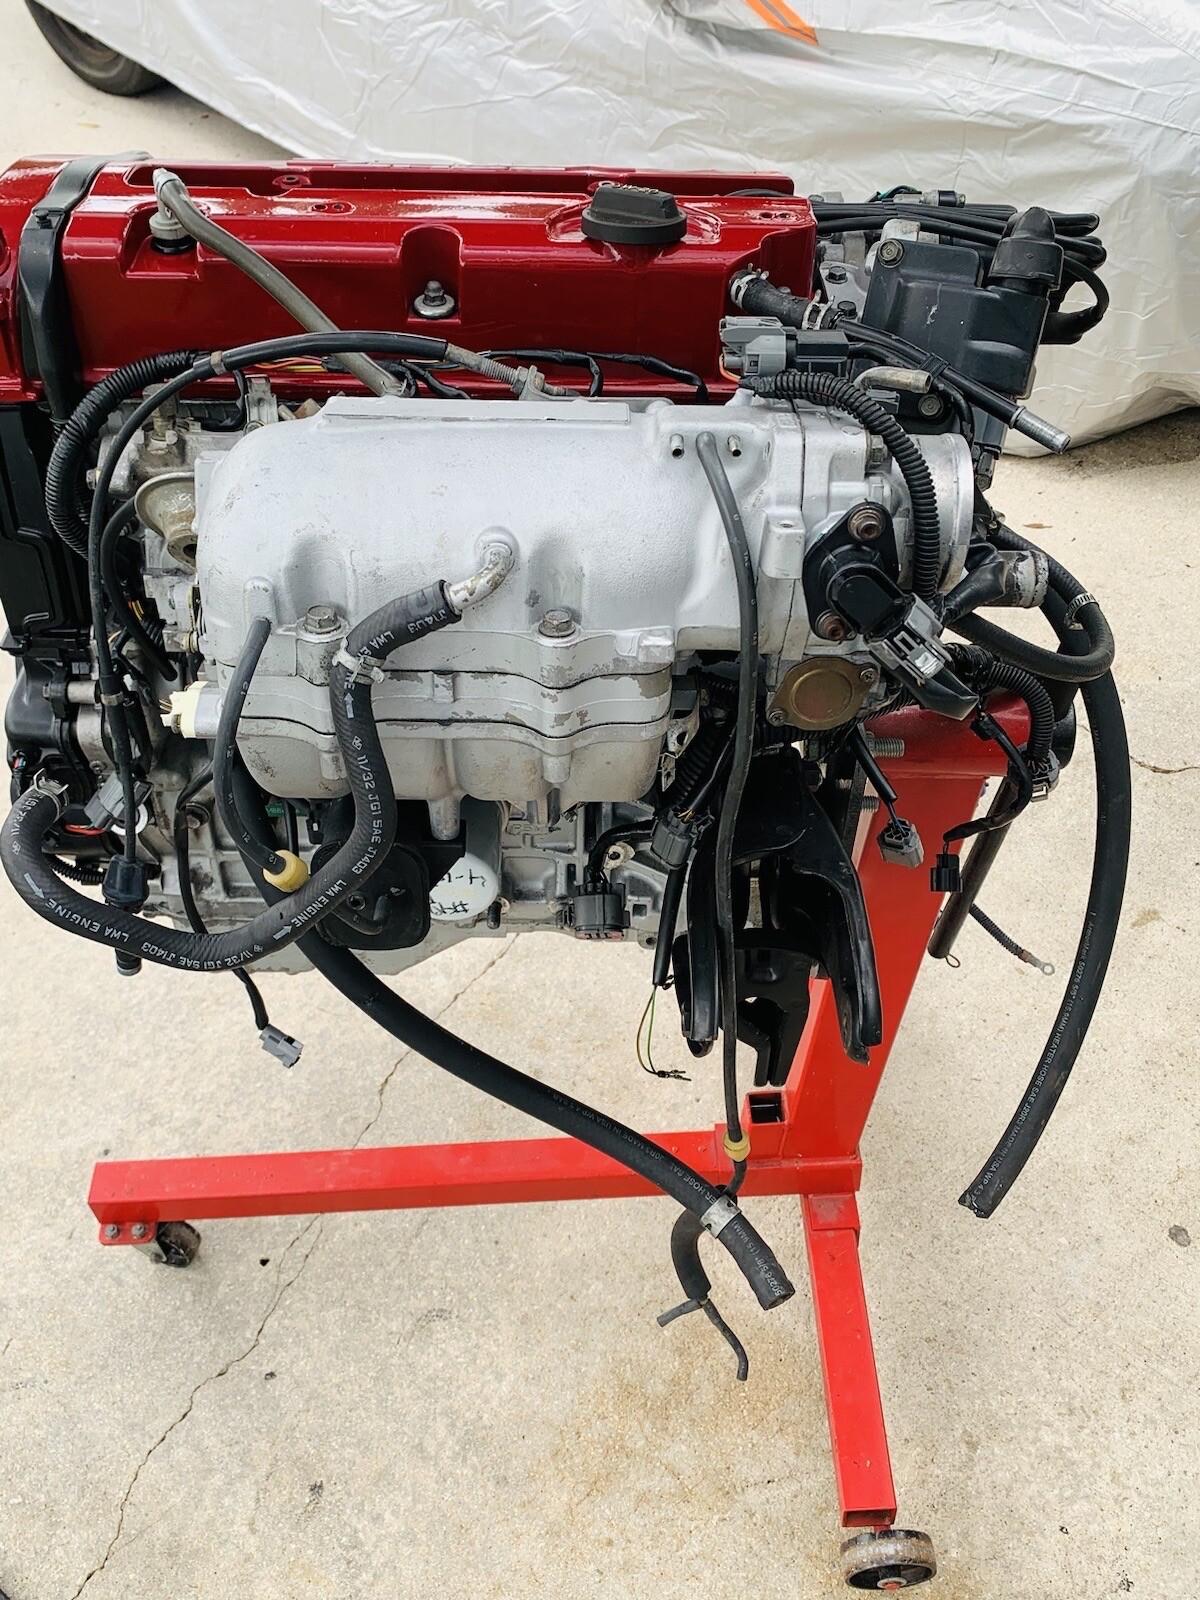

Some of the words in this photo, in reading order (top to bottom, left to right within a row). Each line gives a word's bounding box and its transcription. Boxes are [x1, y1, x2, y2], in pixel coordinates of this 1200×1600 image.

[369, 630, 395, 649] LWA
[357, 754, 376, 790] 11/32
[371, 819, 383, 844] SAE
[351, 846, 378, 875] J1403
[325, 878, 347, 897] LWA
[45, 898, 101, 933] ENGINE
[290, 895, 329, 928] ENGINE
[104, 926, 130, 943] LWA
[141, 941, 176, 962] J1403
[226, 951, 254, 966] 11/32
[178, 956, 200, 970] SAE
[1045, 1031, 1062, 1065] HEATER
[1035, 1064, 1050, 1086] HOSE
[1026, 1086, 1039, 1104] SAE
[595, 1117, 612, 1130] USA
[991, 1157, 1003, 1174] USA
[683, 1175, 706, 1198] HOSE
[982, 1171, 994, 1186] WP
